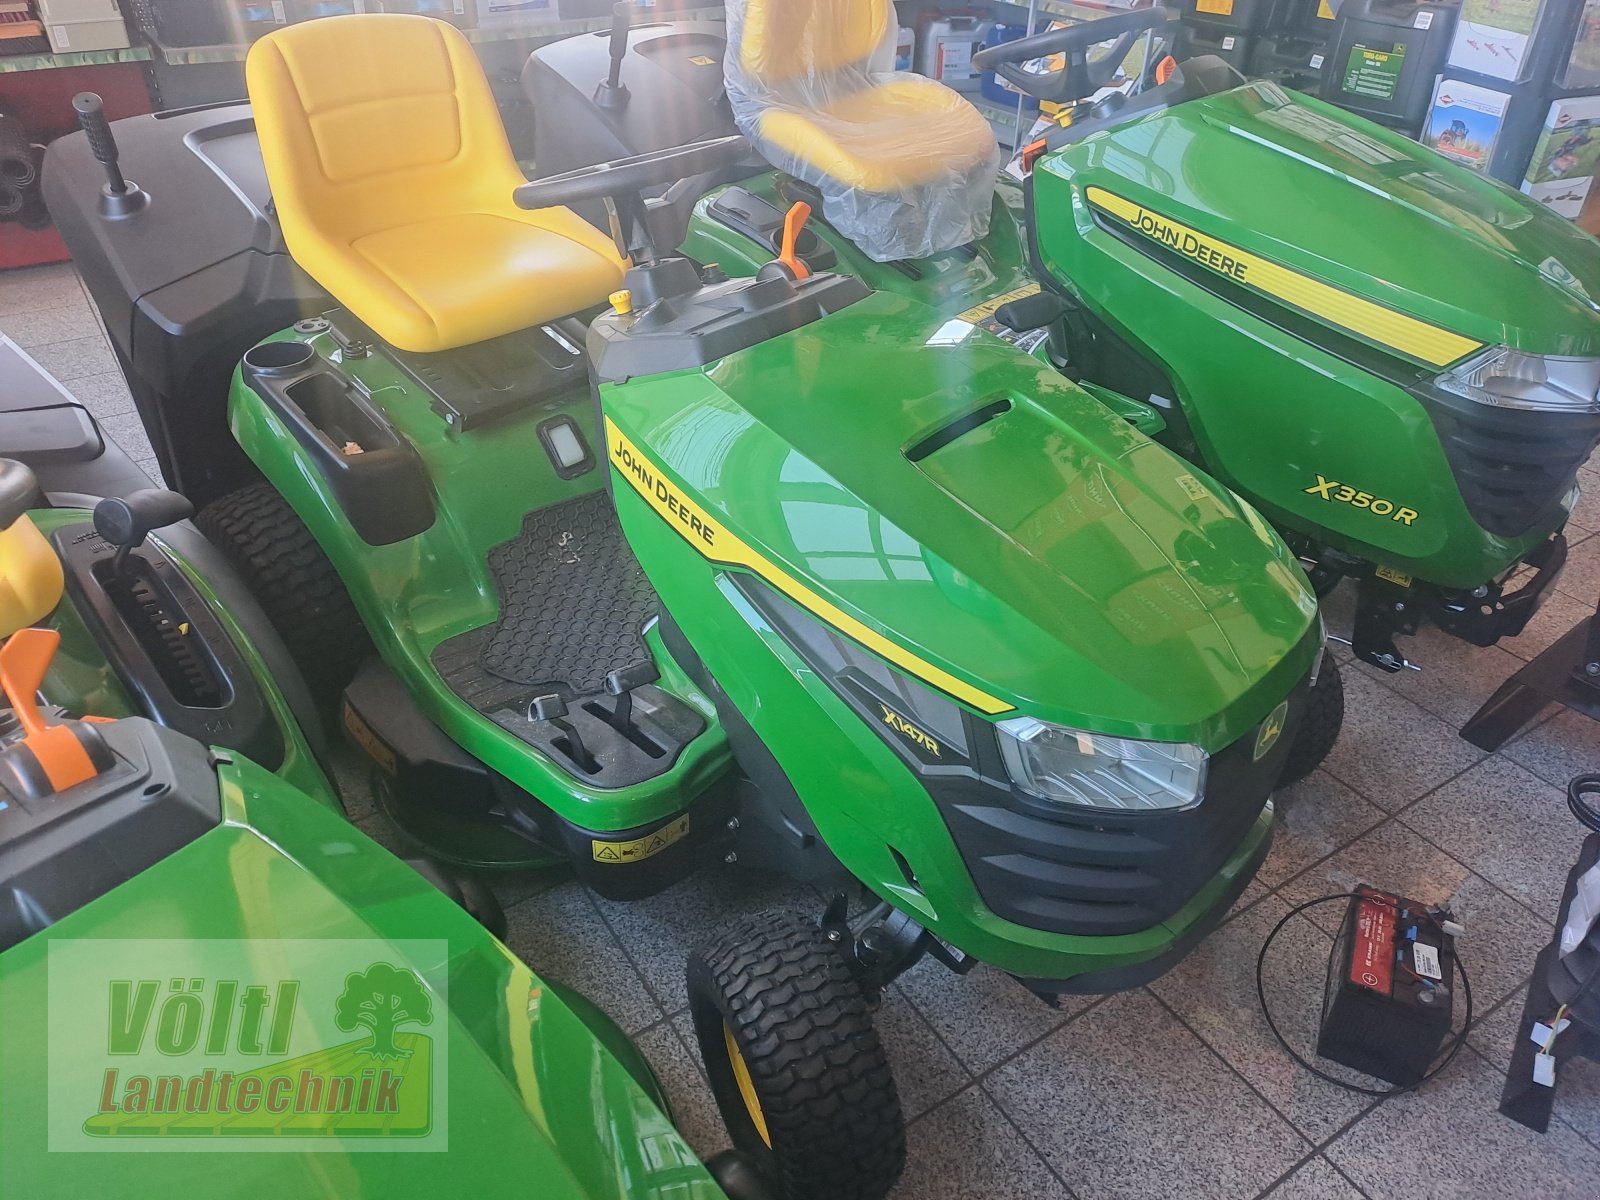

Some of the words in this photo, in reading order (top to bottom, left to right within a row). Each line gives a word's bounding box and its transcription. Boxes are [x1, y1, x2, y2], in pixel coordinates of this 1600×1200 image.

[1130, 209, 1180, 247] JOHN
[1182, 233, 1248, 281] DEERE
[614, 439, 653, 490] JOHN
[656, 478, 715, 547] DEERE
[879, 702, 941, 758] X147R
